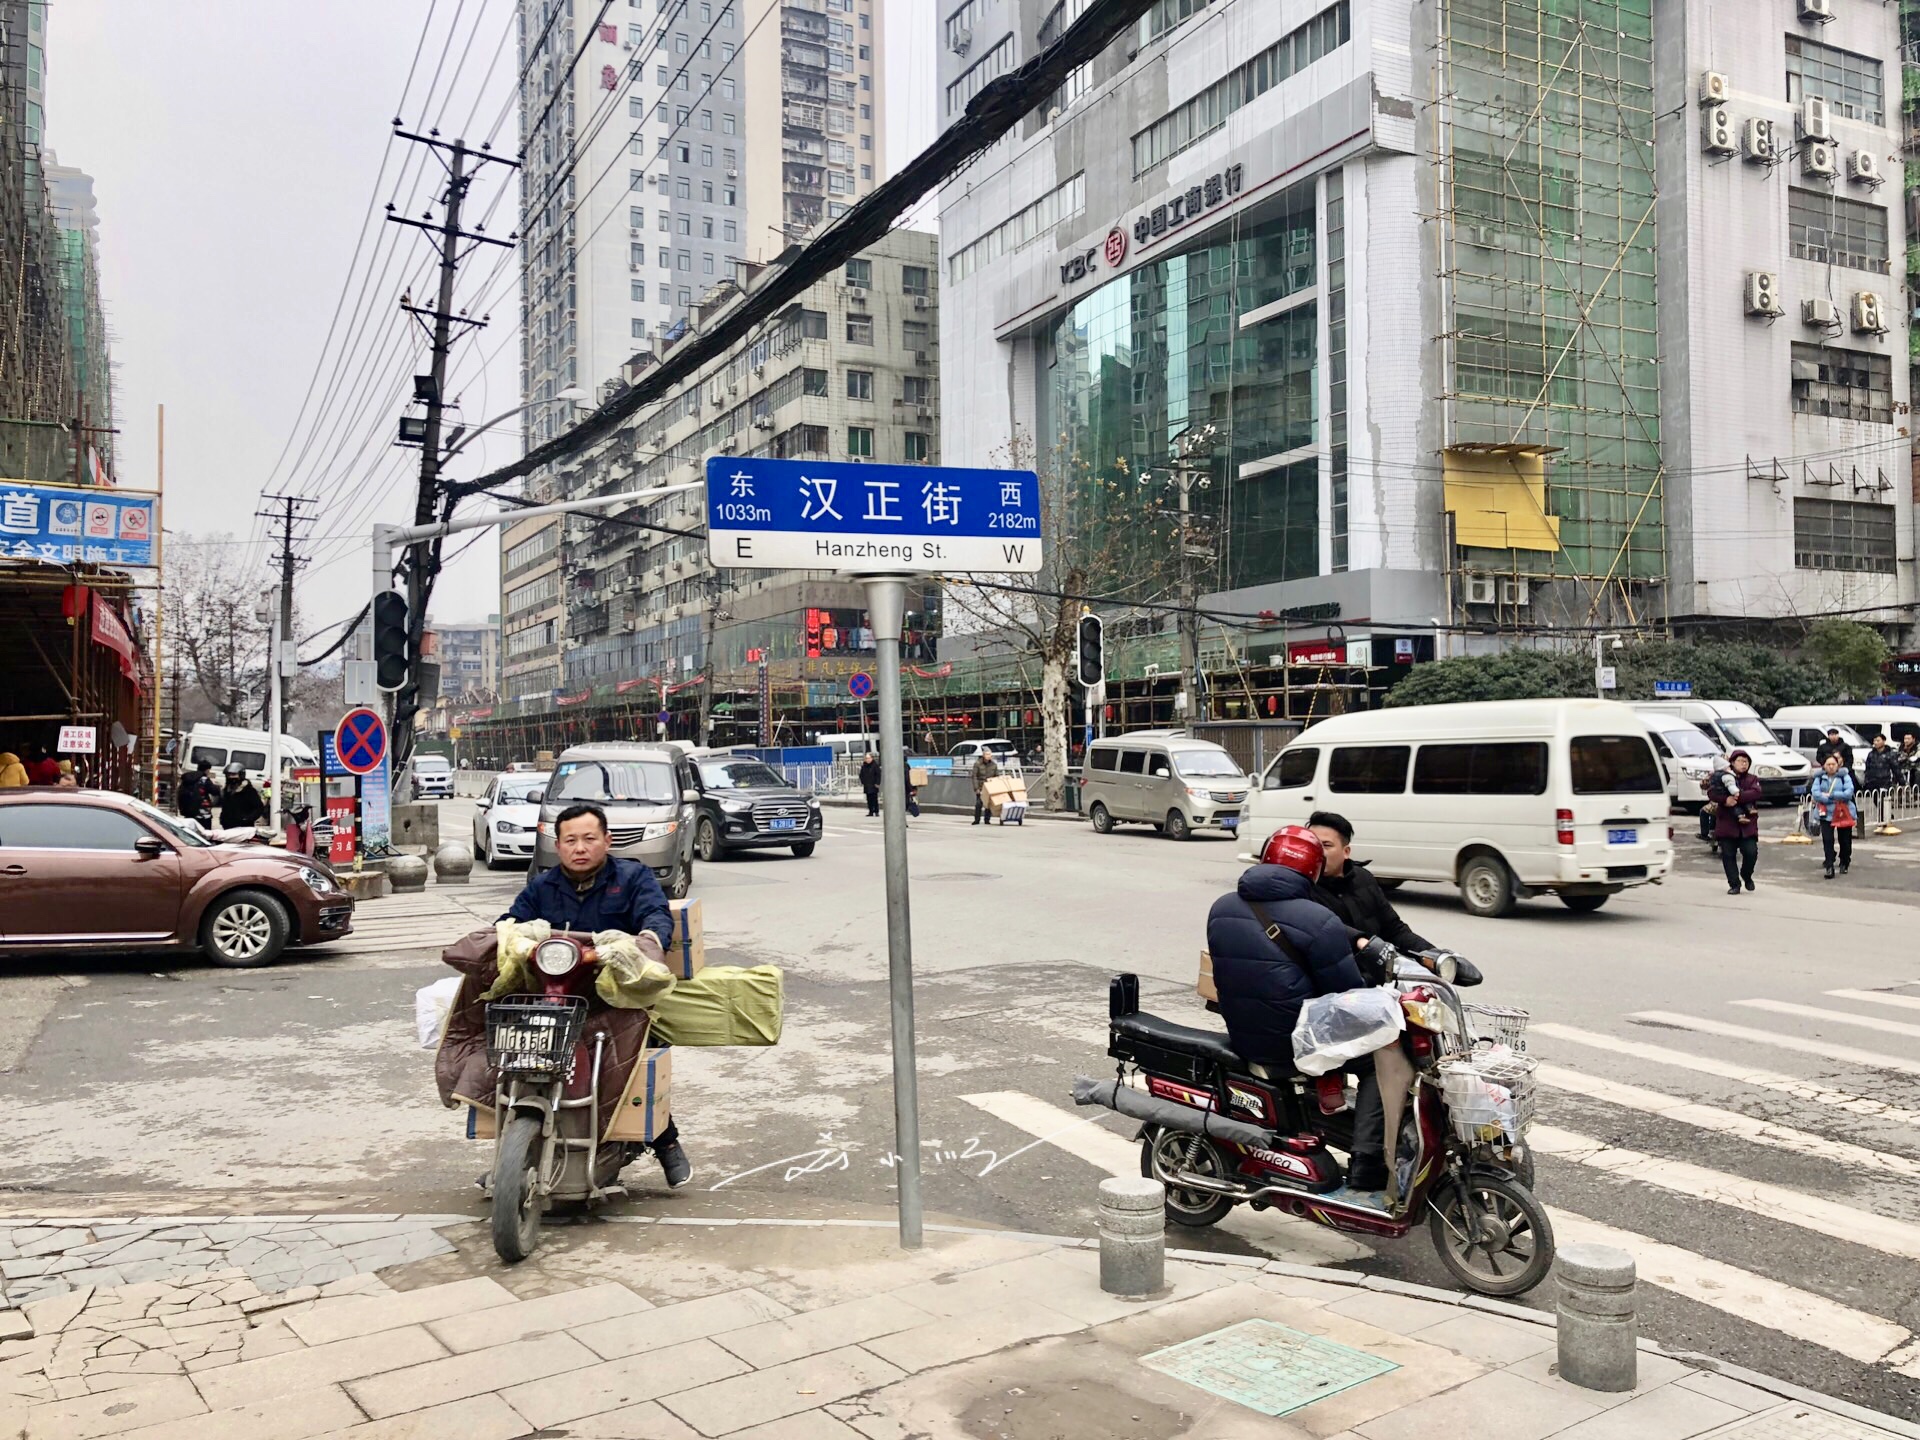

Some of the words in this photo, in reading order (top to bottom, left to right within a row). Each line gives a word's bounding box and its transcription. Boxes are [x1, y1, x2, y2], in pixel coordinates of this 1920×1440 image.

[1134, 162, 1244, 243] 中国工商银行
[729, 470, 755, 498] 东
[998, 481, 1022, 507] 西
[798, 475, 962, 526] 汉正街
[0, 491, 40, 535] 道
[716, 503, 771, 522] 1033m
[988, 512, 1037, 530] 2182m
[736, 537, 753, 559] E
[816, 539, 913, 562] Hanzheng
[922, 542, 947, 559] St.
[1002, 544, 1025, 564] W
[62, 740, 92, 749] 注意安全
